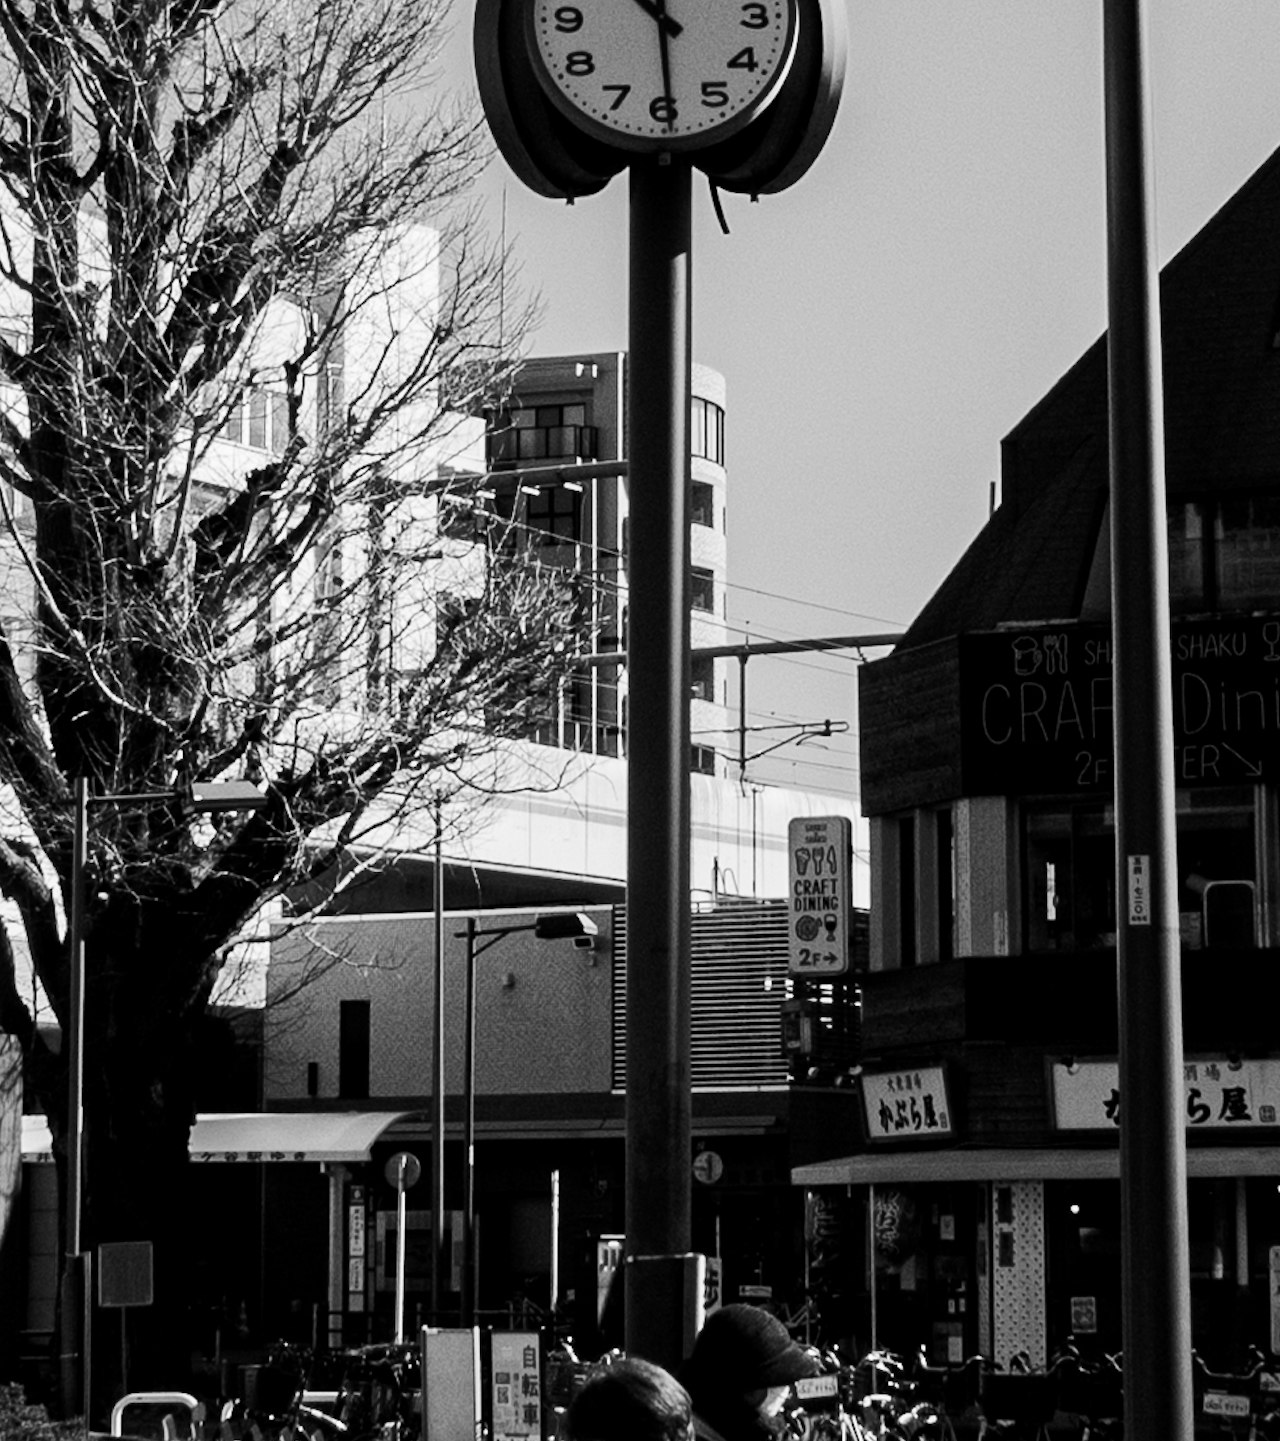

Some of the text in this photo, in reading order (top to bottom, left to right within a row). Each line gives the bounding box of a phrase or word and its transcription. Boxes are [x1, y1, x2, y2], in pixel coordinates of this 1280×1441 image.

[554, 7, 583, 33] 9
[740, 3, 768, 29] 3
[566, 51, 595, 76] 8
[727, 47, 758, 72] 4
[602, 85, 631, 110] 7
[701, 82, 728, 107] 5
[650, 96, 678, 122] 6
[1177, 632, 1248, 661] SHAKU
[794, 879, 838, 895] CRAFT
[794, 897, 839, 912] DINING
[799, 948, 822, 966] 2F
[879, 1093, 939, 1134] かぶら屋
[521, 1344, 540, 1427] 自転車
